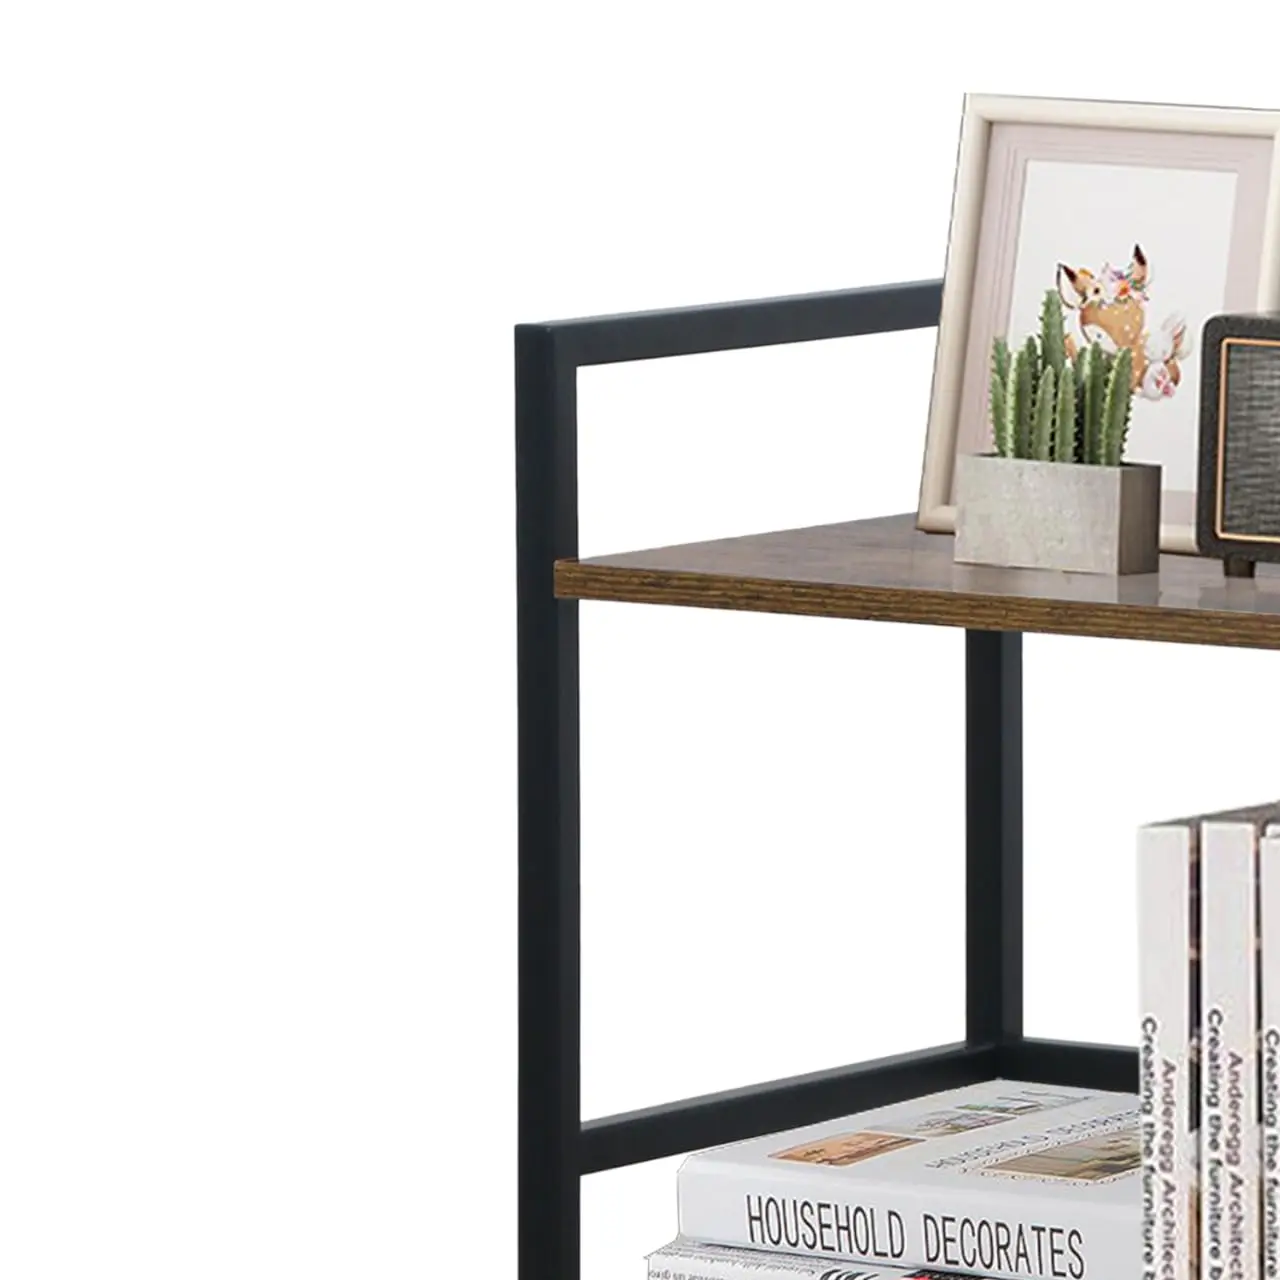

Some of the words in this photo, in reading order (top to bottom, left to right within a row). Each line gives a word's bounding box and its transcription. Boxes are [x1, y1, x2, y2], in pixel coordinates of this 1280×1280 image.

[1142, 1017, 1157, 1115] Creating
[1207, 1008, 1223, 1106] Creating
[1264, 1029, 1280, 1127] Creating
[1142, 1123, 1156, 1159] the
[1159, 1059, 1177, 1173] Anderegg
[1208, 1115, 1222, 1151] the
[1226, 1052, 1244, 1165] Anderegg
[1265, 1135, 1280, 1171] the
[746, 1194, 905, 1259] HOUSEHOLD
[922, 1213, 1085, 1280] DECORATES
[1142, 1165, 1156, 1265] furniture
[1208, 1158, 1222, 1259] furniture
[1265, 1177, 1280, 1278] furniture
